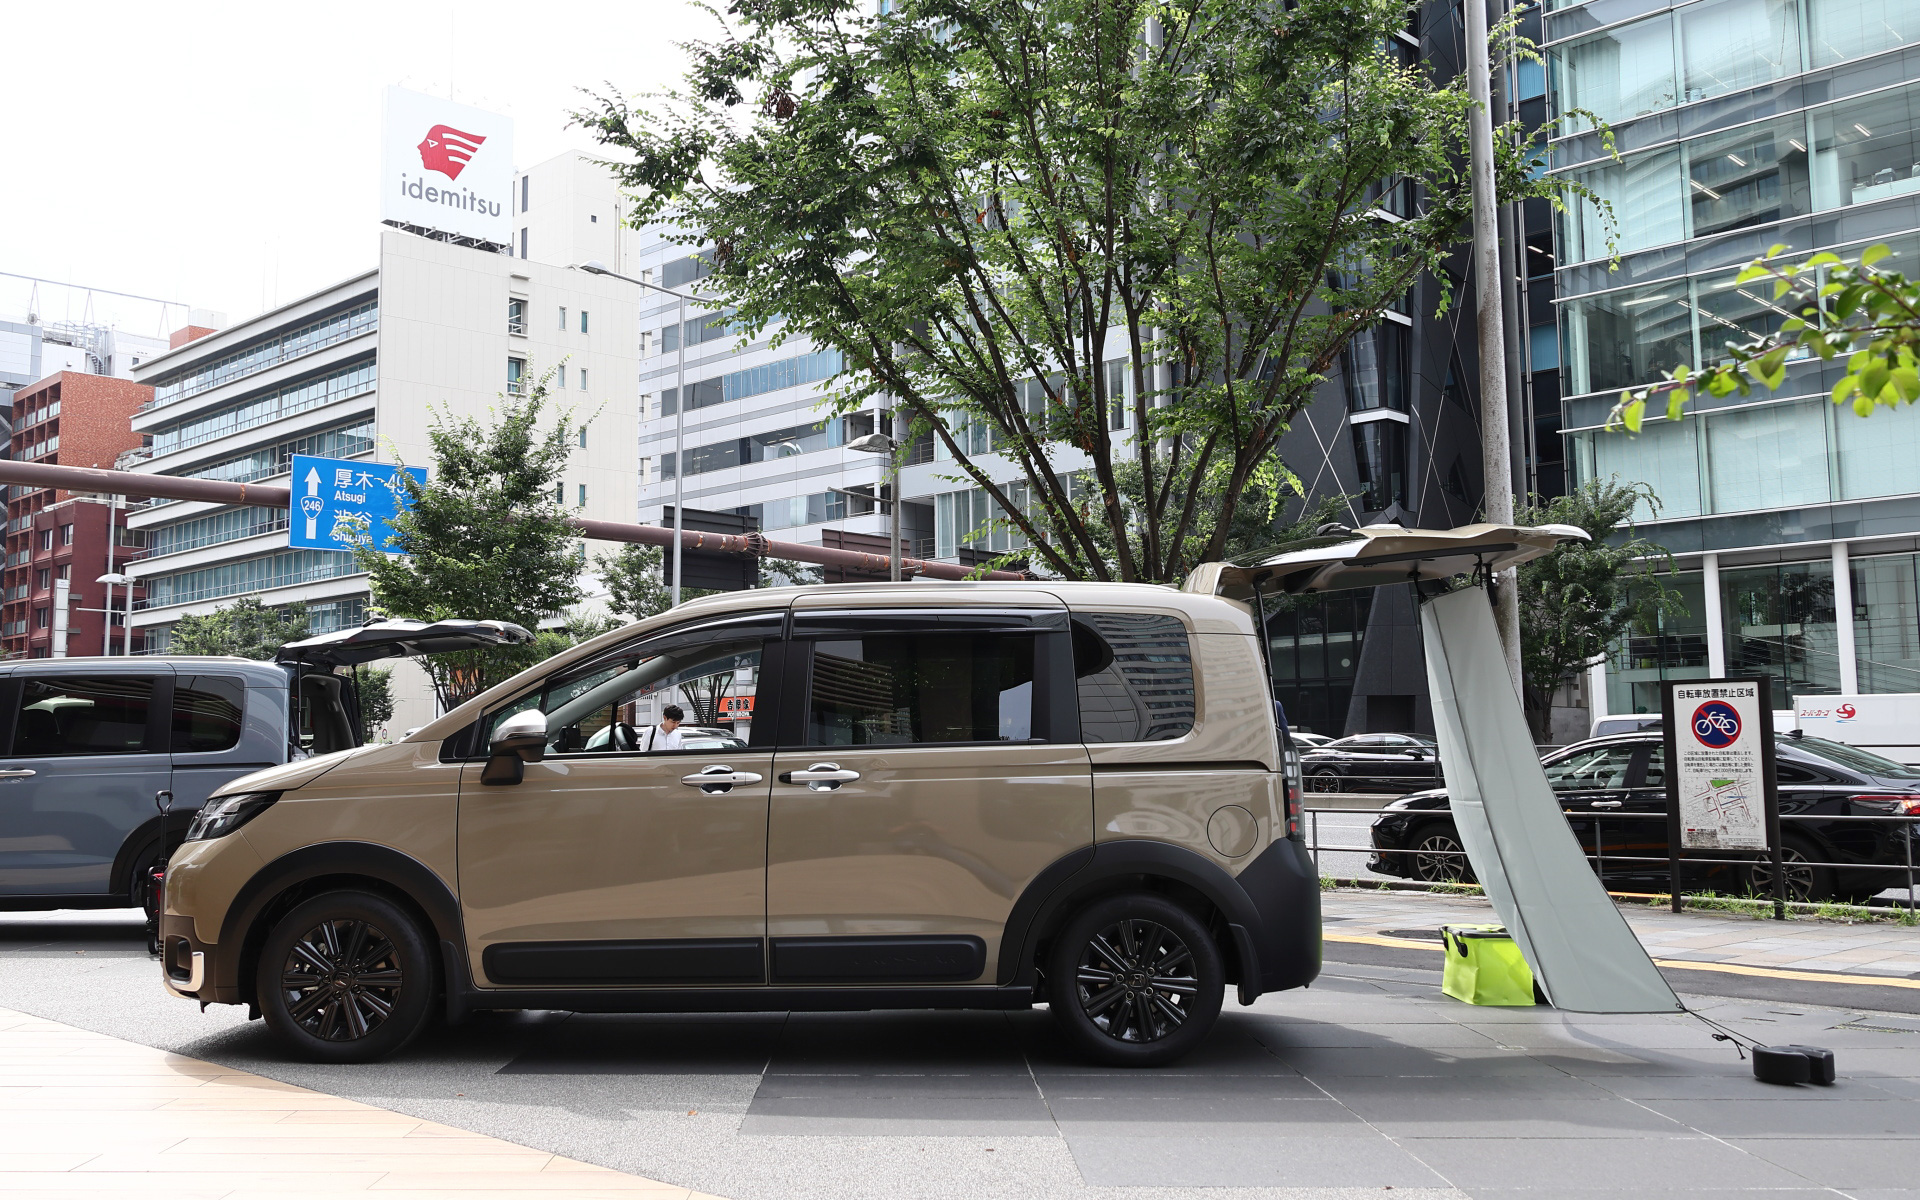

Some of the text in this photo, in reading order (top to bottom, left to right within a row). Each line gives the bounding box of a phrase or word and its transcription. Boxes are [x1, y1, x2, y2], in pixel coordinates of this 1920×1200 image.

[402, 173, 500, 217] idemitsu
[334, 469, 374, 490] 厚木
[334, 491, 366, 504] Atsugi
[305, 500, 320, 511] 246
[1677, 688, 1755, 699] 自転車放置禁止区域
[1800, 709, 1832, 717] スーパーカーゴ
